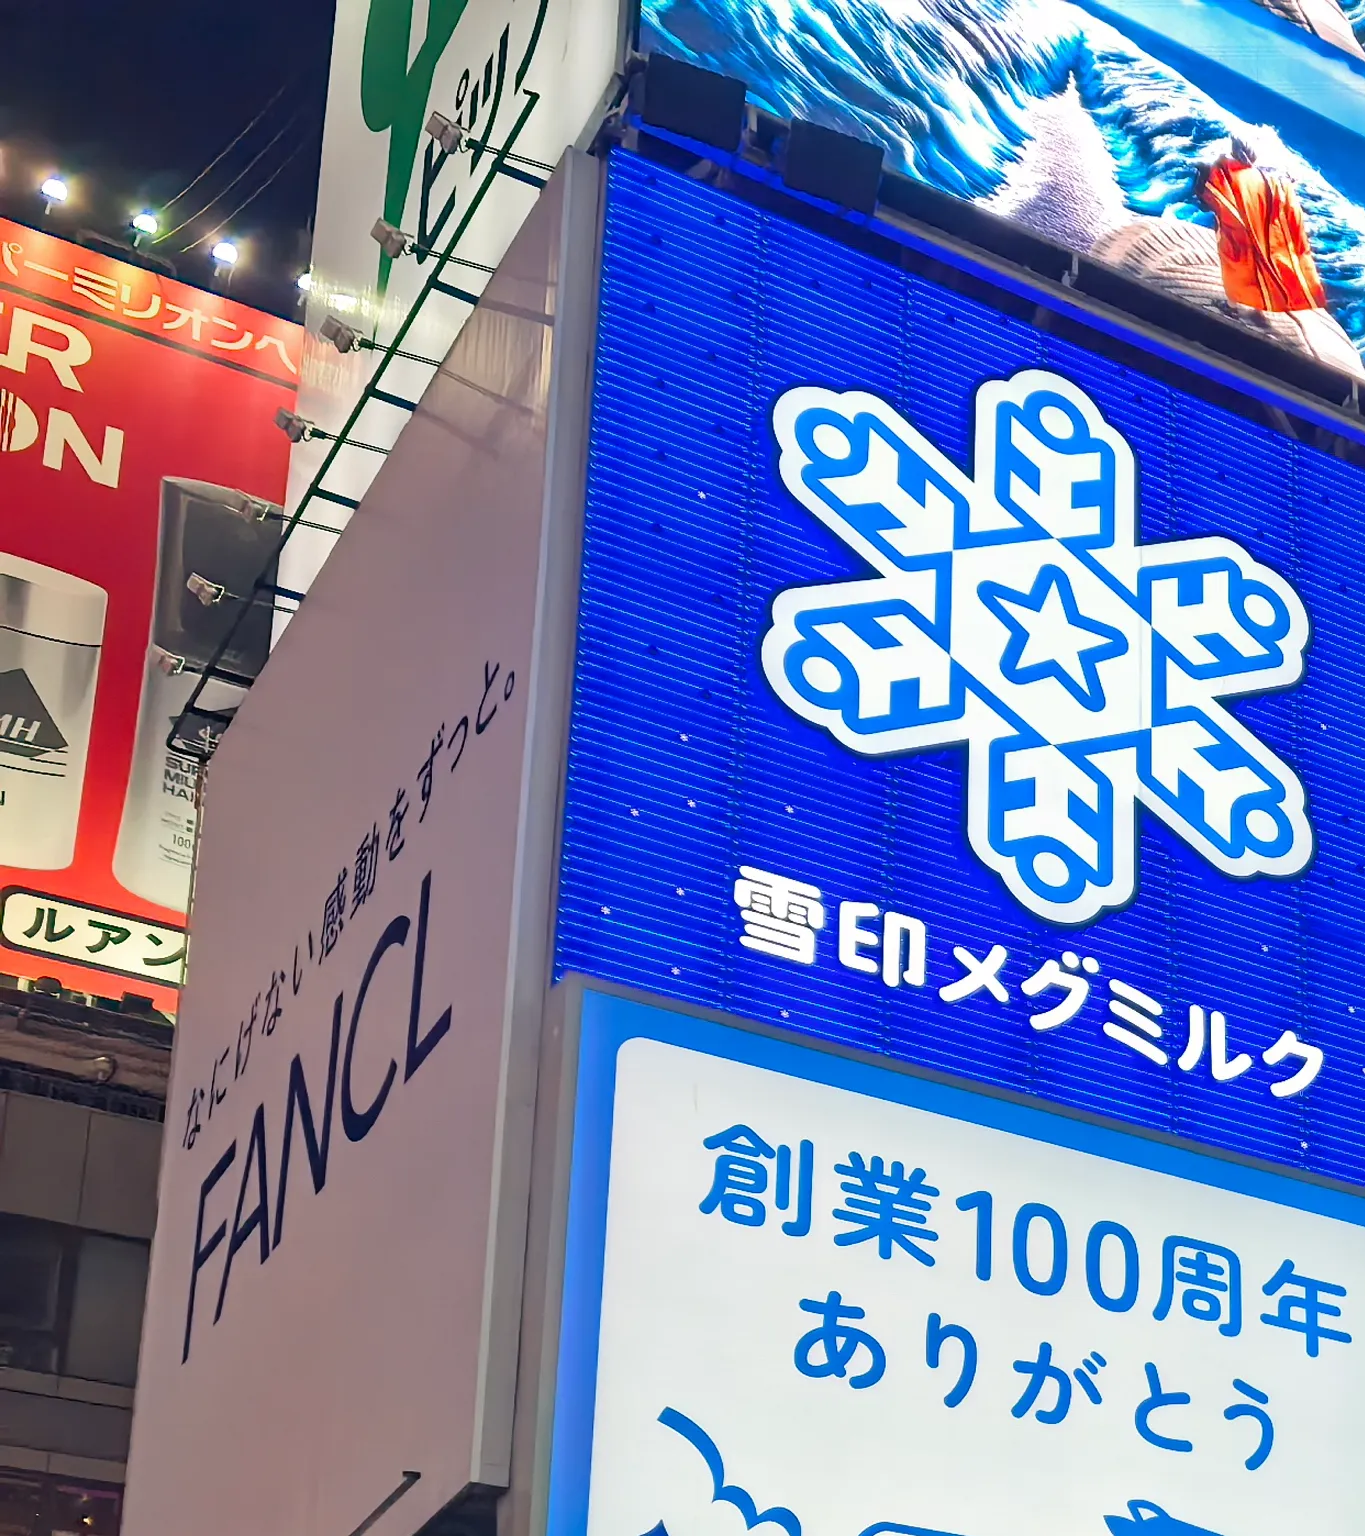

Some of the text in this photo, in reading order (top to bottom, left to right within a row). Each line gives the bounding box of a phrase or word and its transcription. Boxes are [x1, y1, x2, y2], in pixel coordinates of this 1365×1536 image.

[0, 304, 92, 393] R
[182, 660, 516, 1150] なにげない感動をずっと。
[733, 865, 1325, 1100] 雪印メグミルク
[181, 869, 452, 1365] FANCL
[698, 1122, 1354, 1359] 創業100周年
[793, 1290, 1276, 1471] ありがとう
